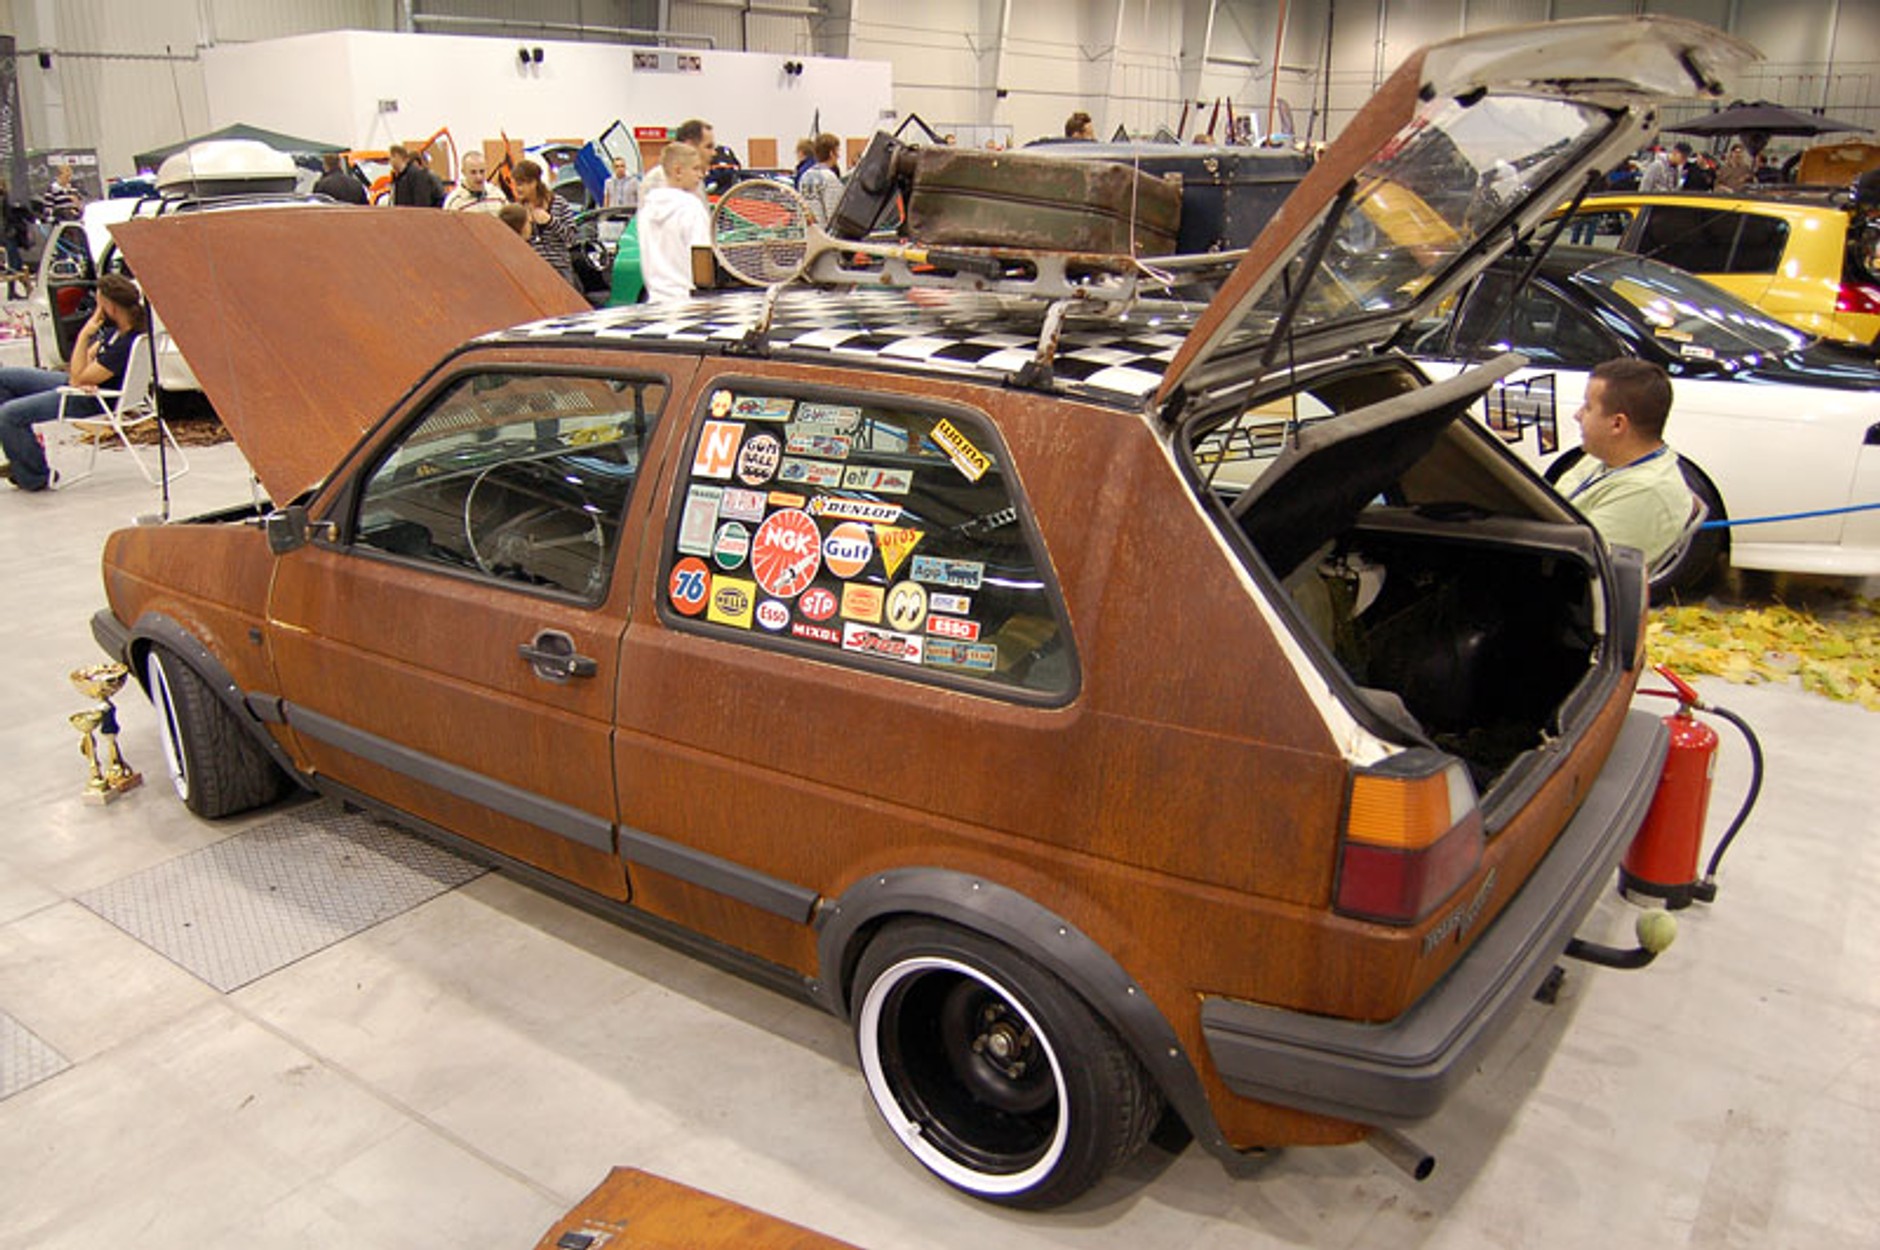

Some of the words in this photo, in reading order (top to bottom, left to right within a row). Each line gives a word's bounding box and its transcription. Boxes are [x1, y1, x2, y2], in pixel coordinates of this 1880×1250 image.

[827, 502, 897, 519] DUNLOP
[764, 527, 812, 555] NGK
[875, 528, 917, 548] LOTOS
[826, 540, 869, 561] Gulf
[675, 571, 705, 603] 76
[803, 591, 833, 616] STP
